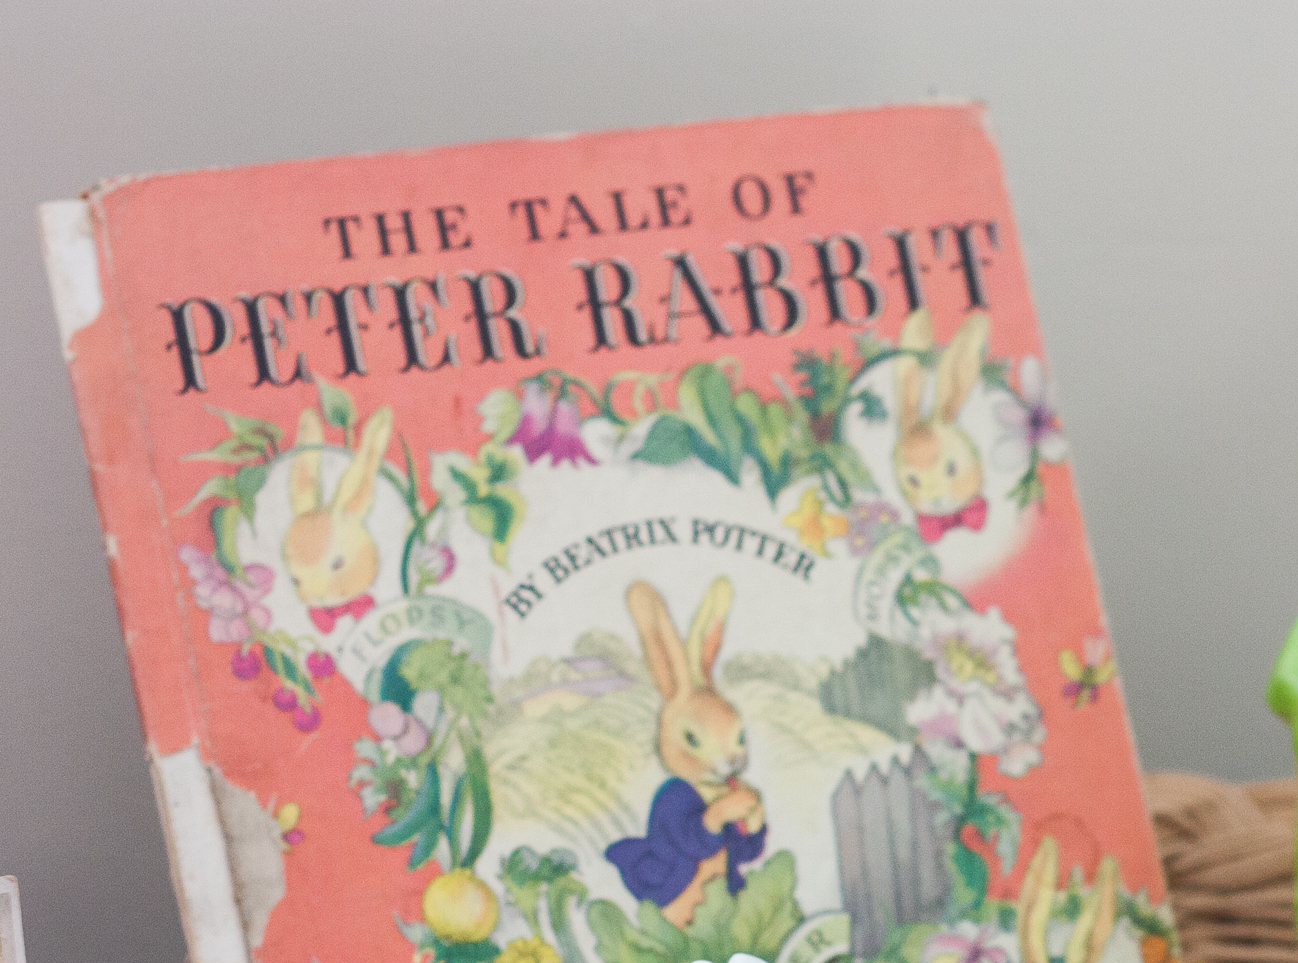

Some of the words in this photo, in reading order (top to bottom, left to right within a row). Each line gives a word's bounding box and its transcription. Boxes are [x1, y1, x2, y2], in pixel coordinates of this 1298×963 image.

[323, 213, 474, 261] THE
[509, 182, 693, 243] TALE
[730, 169, 817, 222] OF
[158, 268, 547, 396] PETER
[569, 220, 1000, 353] RABBIT
[505, 573, 544, 619] BY
[542, 516, 679, 585] BEATRIX
[692, 517, 816, 582] POTTER
[337, 602, 476, 664] FLOPSY
